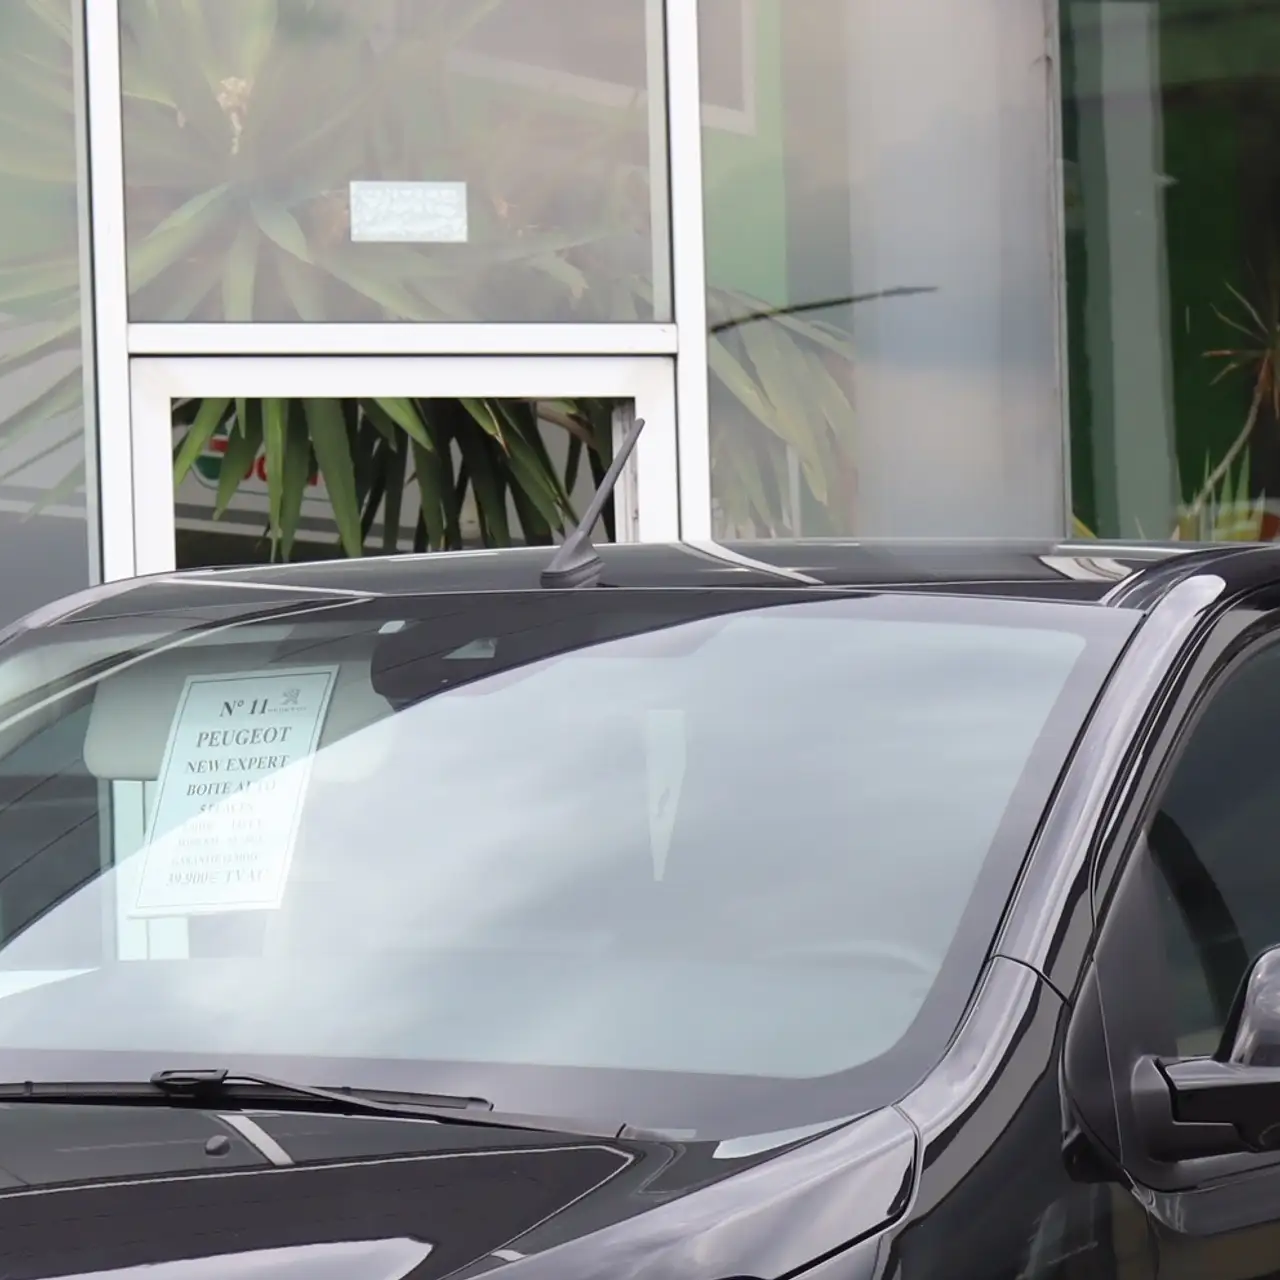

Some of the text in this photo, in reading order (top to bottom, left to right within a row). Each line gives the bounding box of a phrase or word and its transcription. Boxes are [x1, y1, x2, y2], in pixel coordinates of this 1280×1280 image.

[250, 699, 269, 716] 11
[195, 726, 292, 749] PEUGEOT
[185, 755, 290, 775] NEW EXPERT
[186, 782, 232, 797] BOITE
